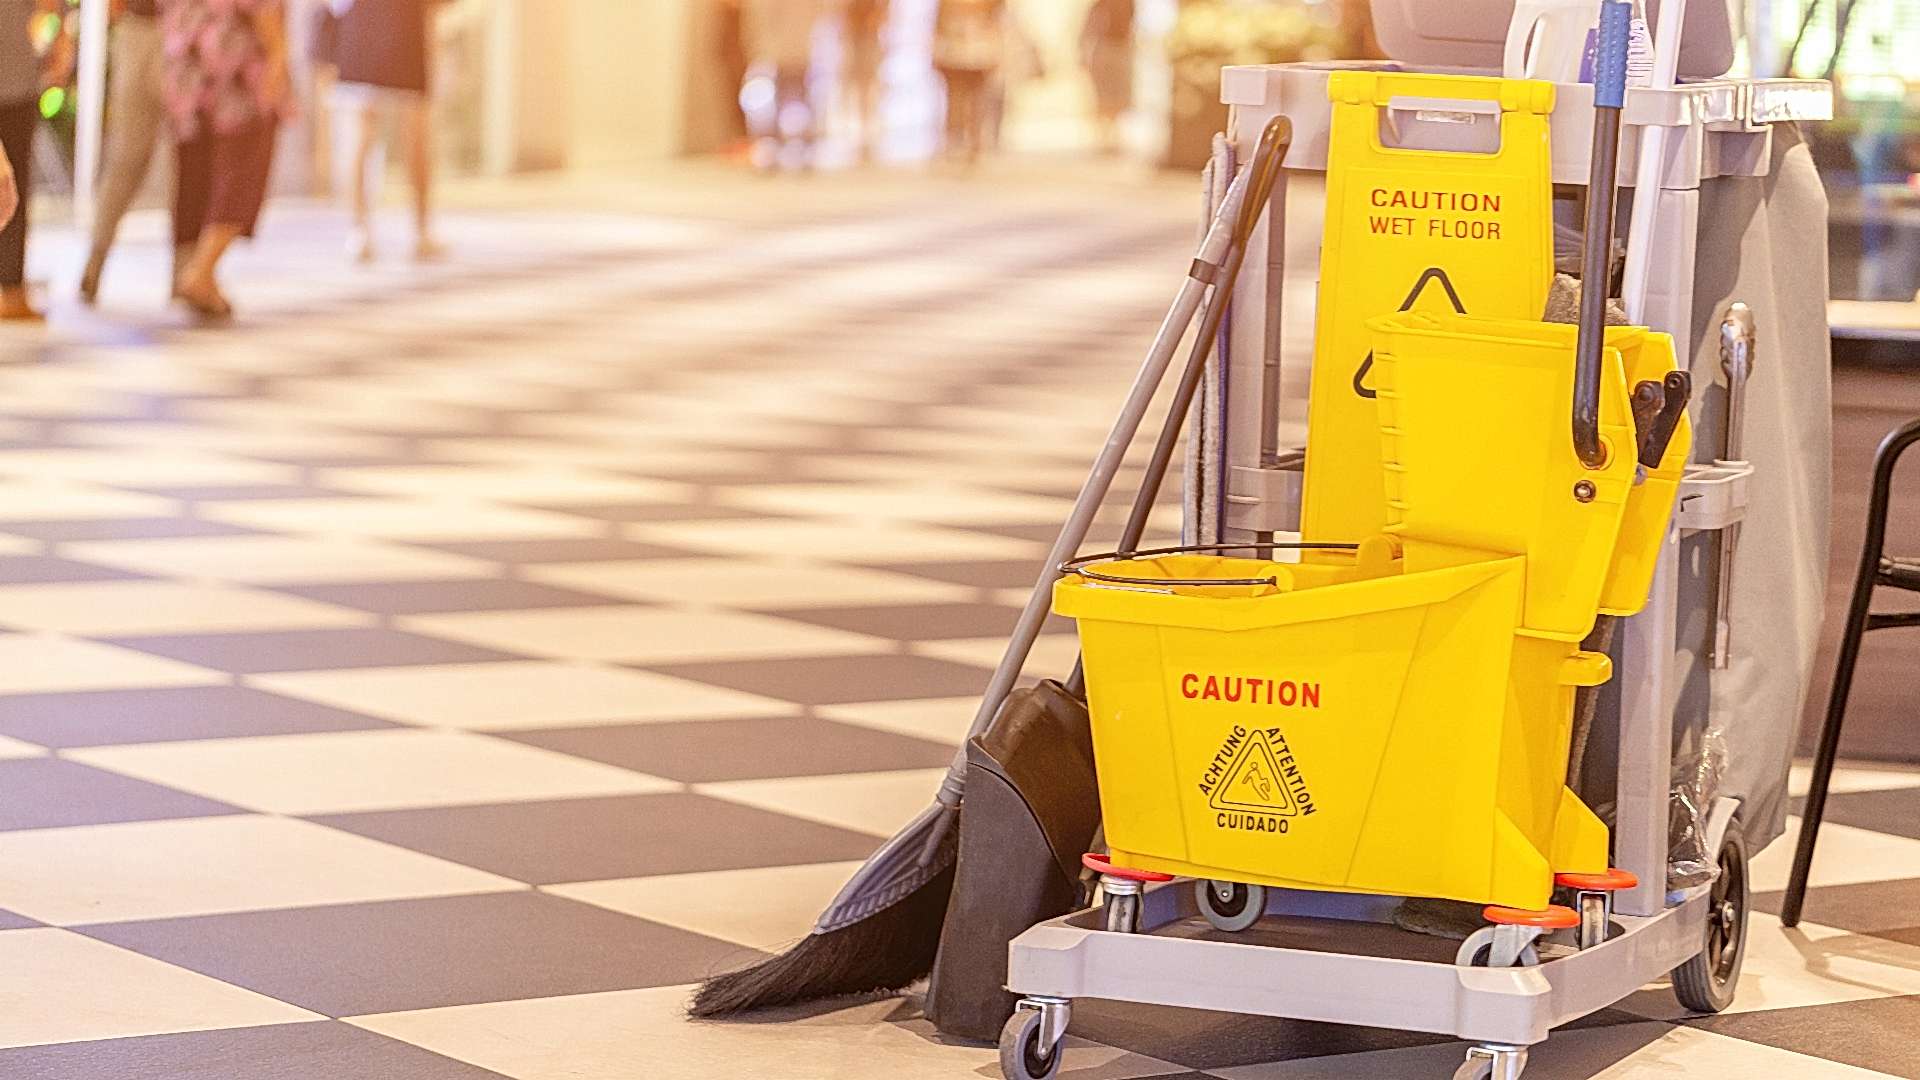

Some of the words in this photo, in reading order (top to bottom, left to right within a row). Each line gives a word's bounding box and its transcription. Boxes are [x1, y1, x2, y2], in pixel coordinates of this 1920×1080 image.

[1371, 188, 1501, 212] CAUTION
[1369, 215, 1417, 236] WET
[1429, 219, 1501, 240] FLOOR
[1181, 673, 1320, 708] CAUTION
[1198, 724, 1247, 796] ACHTUNG
[1266, 727, 1317, 816] ATTENTION
[1217, 813, 1289, 834] CUIDADO
